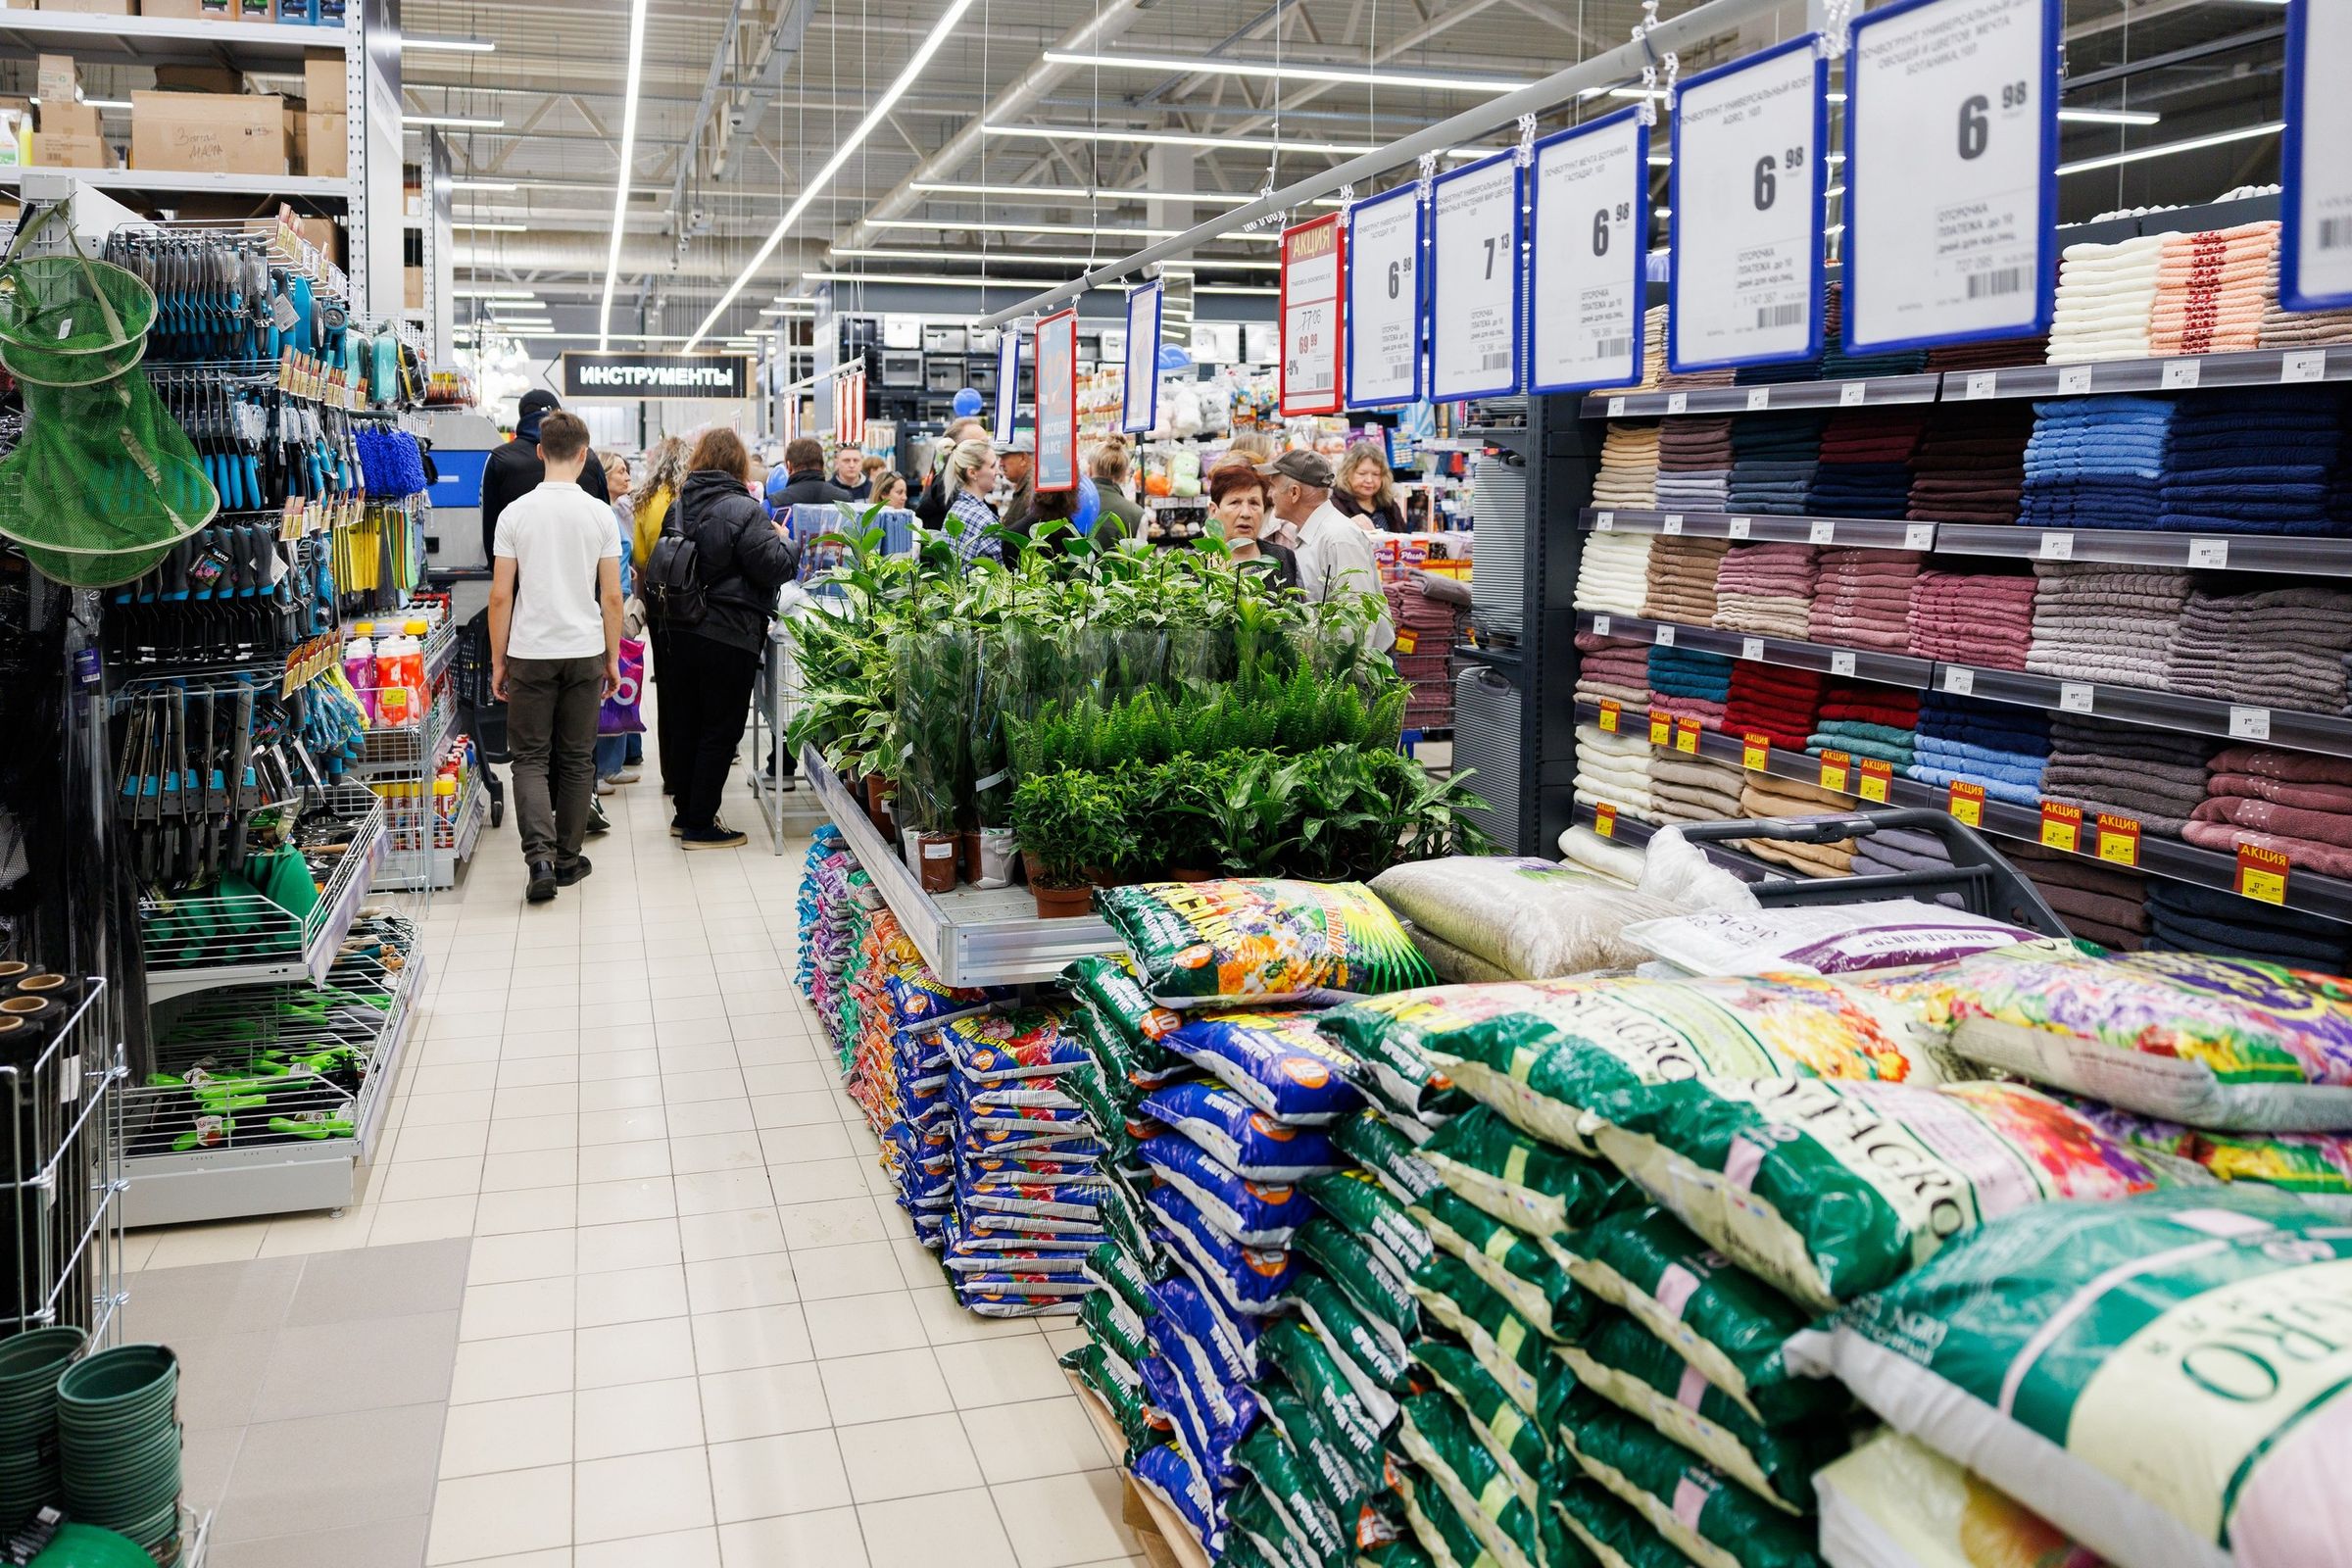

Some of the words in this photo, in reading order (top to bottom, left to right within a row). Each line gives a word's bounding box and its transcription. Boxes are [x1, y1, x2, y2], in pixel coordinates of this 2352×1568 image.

[1958, 94, 1989, 161] 6
[2002, 80, 2027, 109] 98
[1754, 155, 1777, 211] 6
[1786, 146, 1804, 169] 98
[1592, 208, 1609, 257] 6
[1615, 202, 1630, 221] 98
[1293, 227, 1331, 259] АКЦИЯ
[1484, 237, 1495, 280] 7
[1500, 233, 1509, 250] 13
[1388, 261, 1399, 299] 6
[1403, 257, 1412, 271] 98
[1298, 336, 1308, 354] 69
[1309, 333, 1318, 347] 99
[579, 366, 733, 386] ИНСТРУМЕНТЫ
[1287, 360, 1298, 376] -9%
[213, 550, 229, 563] SATO
[272, 707, 287, 720] SATO
[1650, 710, 1672, 721] АКЦИЯ
[1680, 718, 1700, 728] АКЦИЯ
[1745, 733, 1769, 745] АКЦИЯ
[1822, 751, 1850, 762] АКЦИЯ
[1862, 760, 1892, 772] АКЦИЯ
[1951, 781, 1984, 797] АКЦИЯ
[2044, 803, 2081, 819] АКЦИЯ
[2099, 814, 2137, 832] АКЦИЯ
[2240, 845, 2286, 866] АКЦИЯ
[912, 977, 952, 998] ЦВЕТОВ
[974, 1035, 1018, 1059] ЦВЕТОВ
